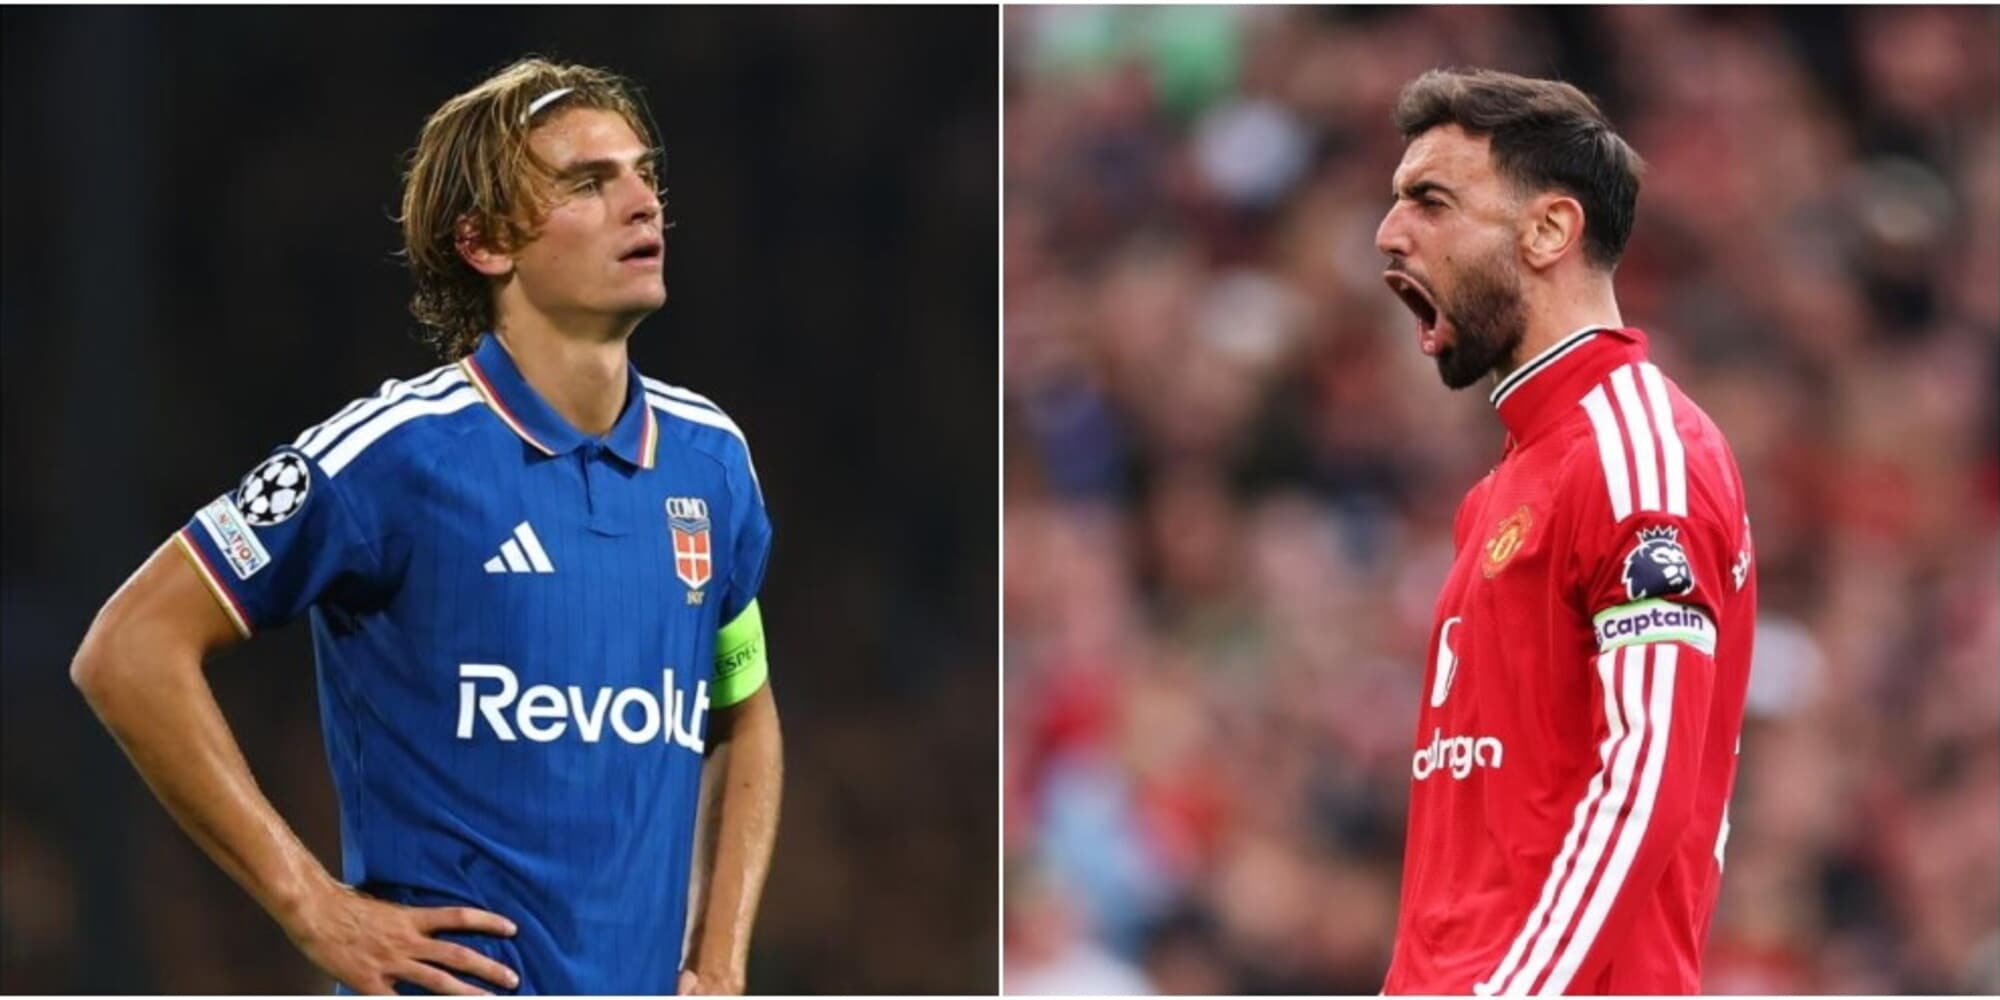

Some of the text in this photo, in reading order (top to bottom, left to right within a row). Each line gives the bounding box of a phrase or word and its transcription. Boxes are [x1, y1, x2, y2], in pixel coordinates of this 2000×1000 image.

[1603, 606, 1703, 639] Captain
[714, 642, 757, 676] ESPEC
[456, 663, 710, 754] Revolut
